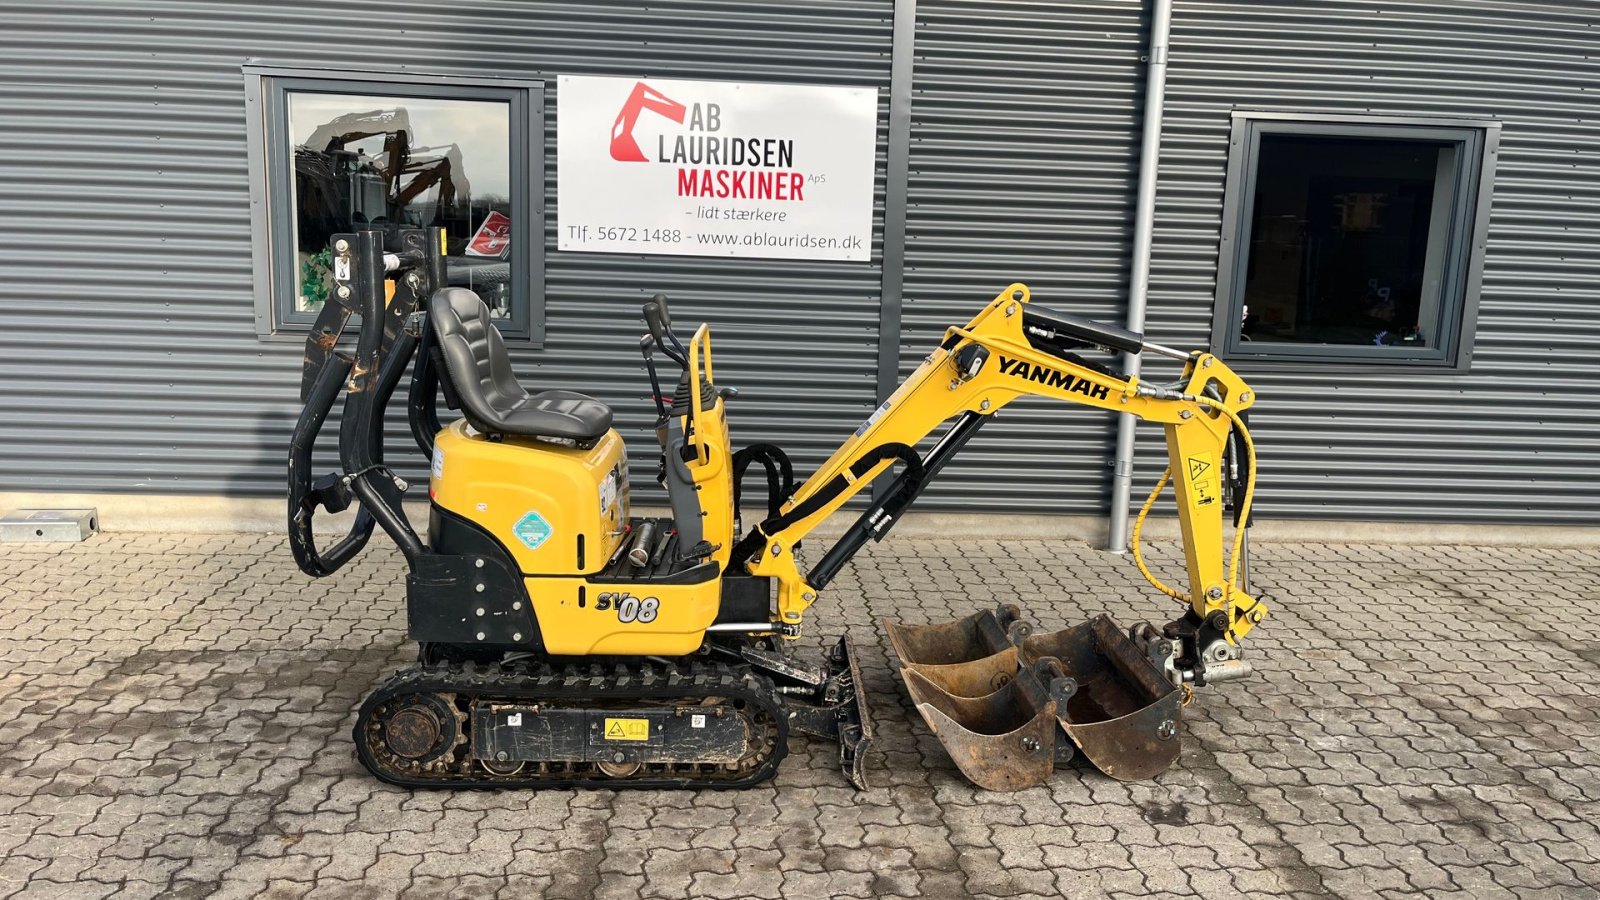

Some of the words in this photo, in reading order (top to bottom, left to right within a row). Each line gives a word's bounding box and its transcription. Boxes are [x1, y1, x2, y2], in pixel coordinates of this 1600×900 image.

[690, 102, 721, 132] AB
[658, 134, 794, 168] LAURIDSEN
[678, 168, 805, 201] MASKINER
[808, 173, 827, 184] ApS
[697, 205, 720, 220] lidt
[722, 207, 787, 223] stærkere
[567, 225, 593, 244] Tlf.
[597, 226, 638, 242] 5672
[642, 228, 682, 244] 1488
[697, 231, 862, 250] www.ablauridsen.dk
[998, 355, 1111, 401] YANMAR
